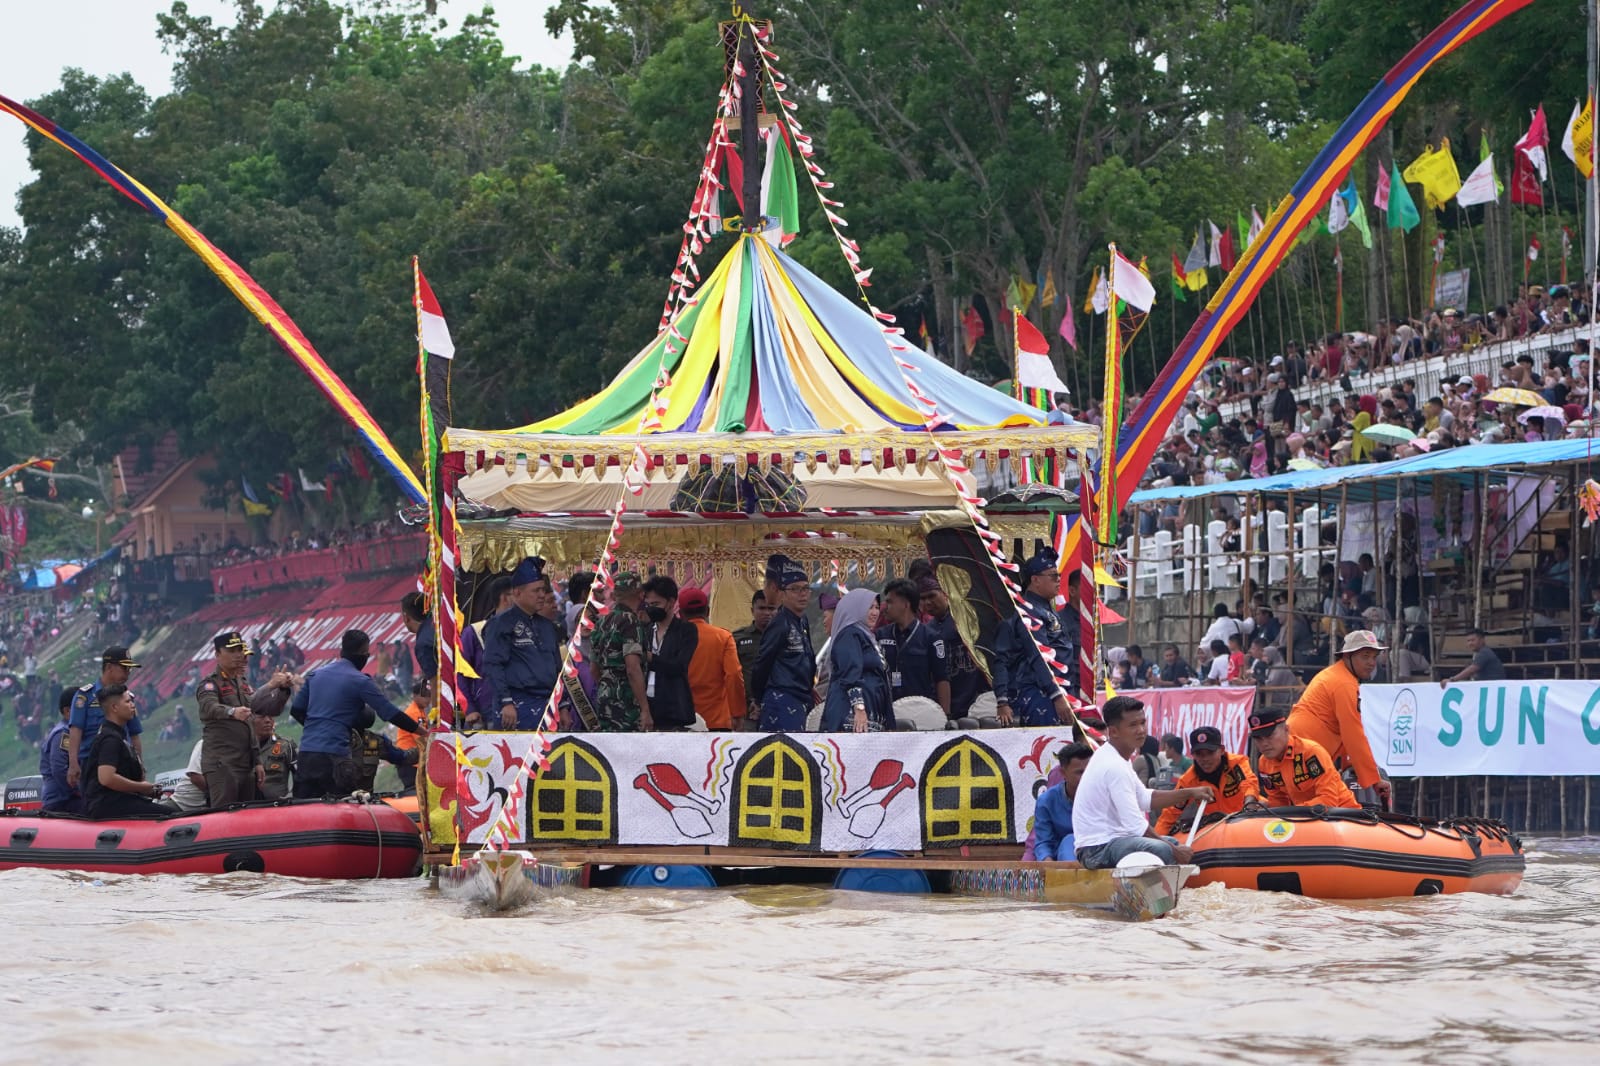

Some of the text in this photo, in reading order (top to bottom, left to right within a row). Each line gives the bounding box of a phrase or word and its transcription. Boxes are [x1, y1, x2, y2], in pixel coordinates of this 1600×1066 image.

[1438, 686, 1549, 747] SUN
[1392, 738, 1413, 754] SUN
[14, 789, 38, 800] YAMAHA
